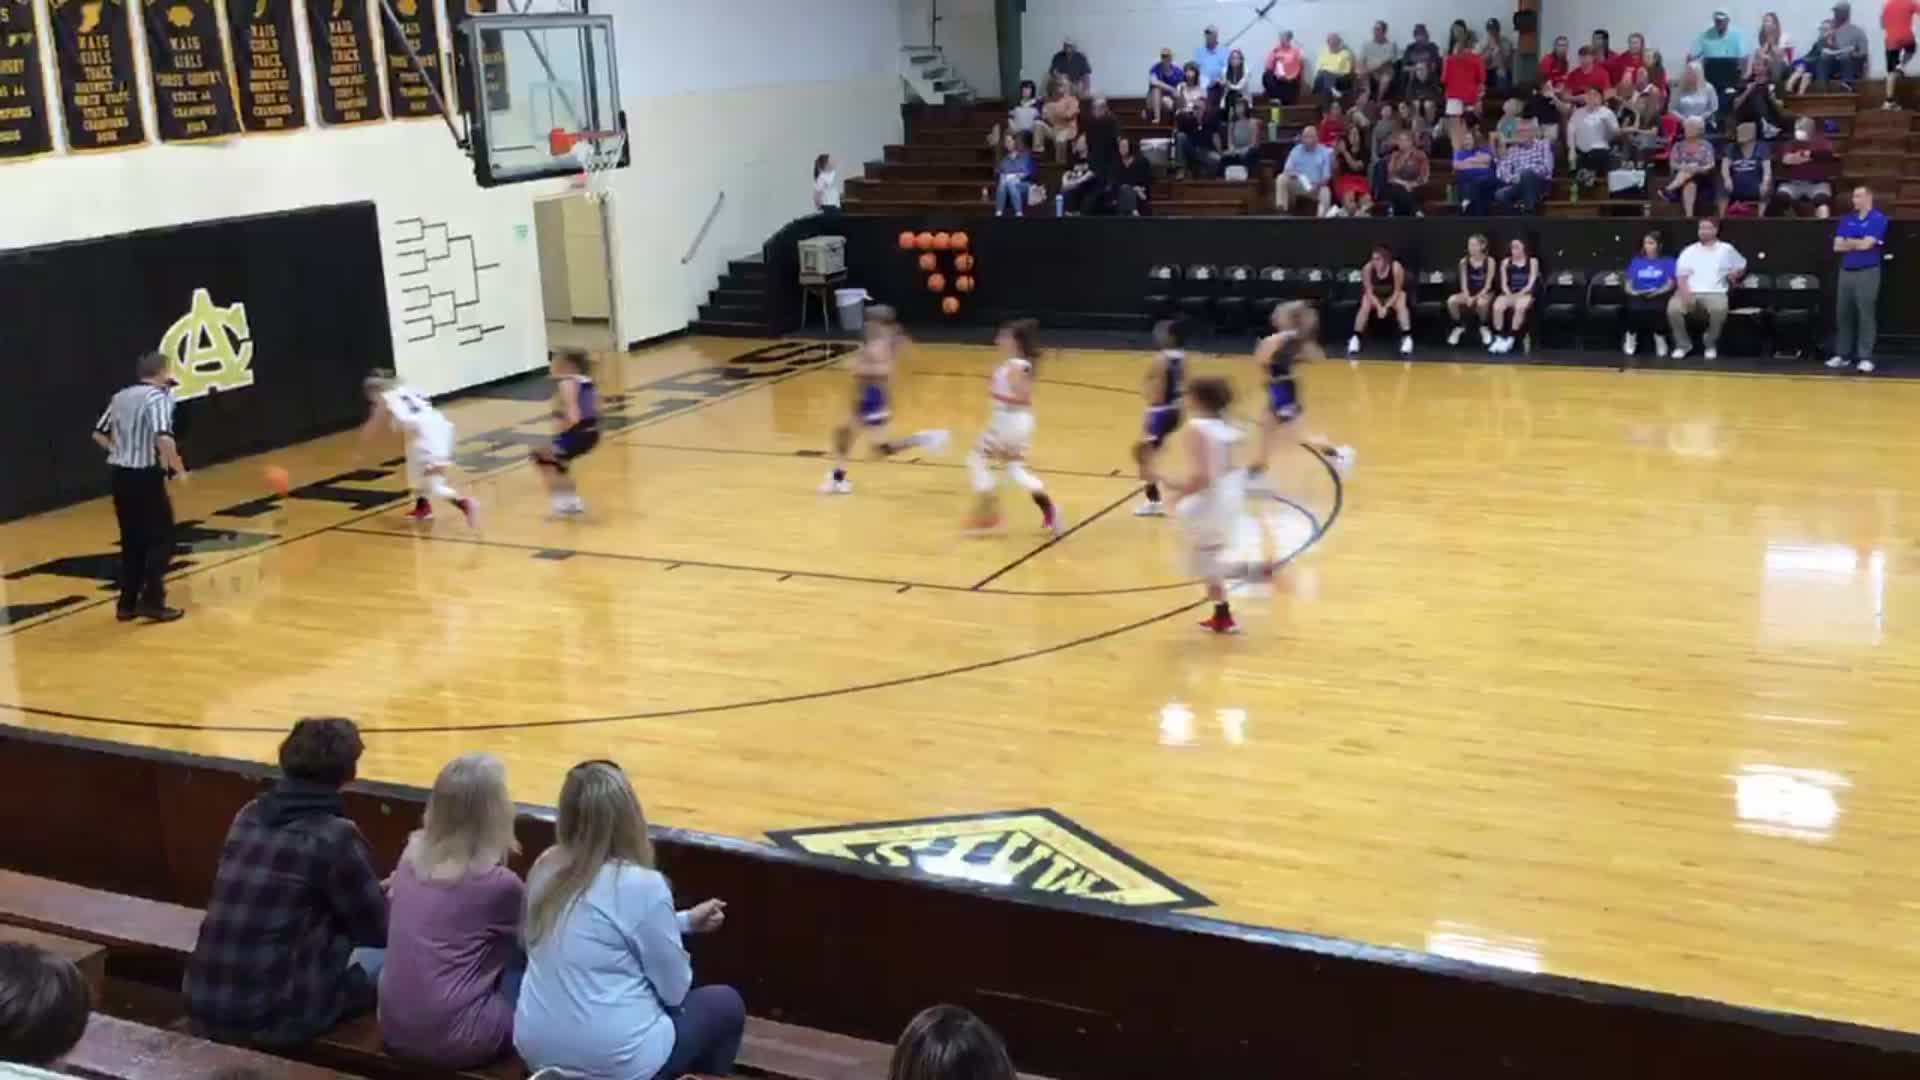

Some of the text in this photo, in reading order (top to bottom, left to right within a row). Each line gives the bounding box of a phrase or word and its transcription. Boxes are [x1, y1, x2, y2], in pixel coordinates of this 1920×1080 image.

[249, 24, 276, 37] MAIS
[77, 34, 110, 49] MAIS
[169, 36, 201, 50] MAIS
